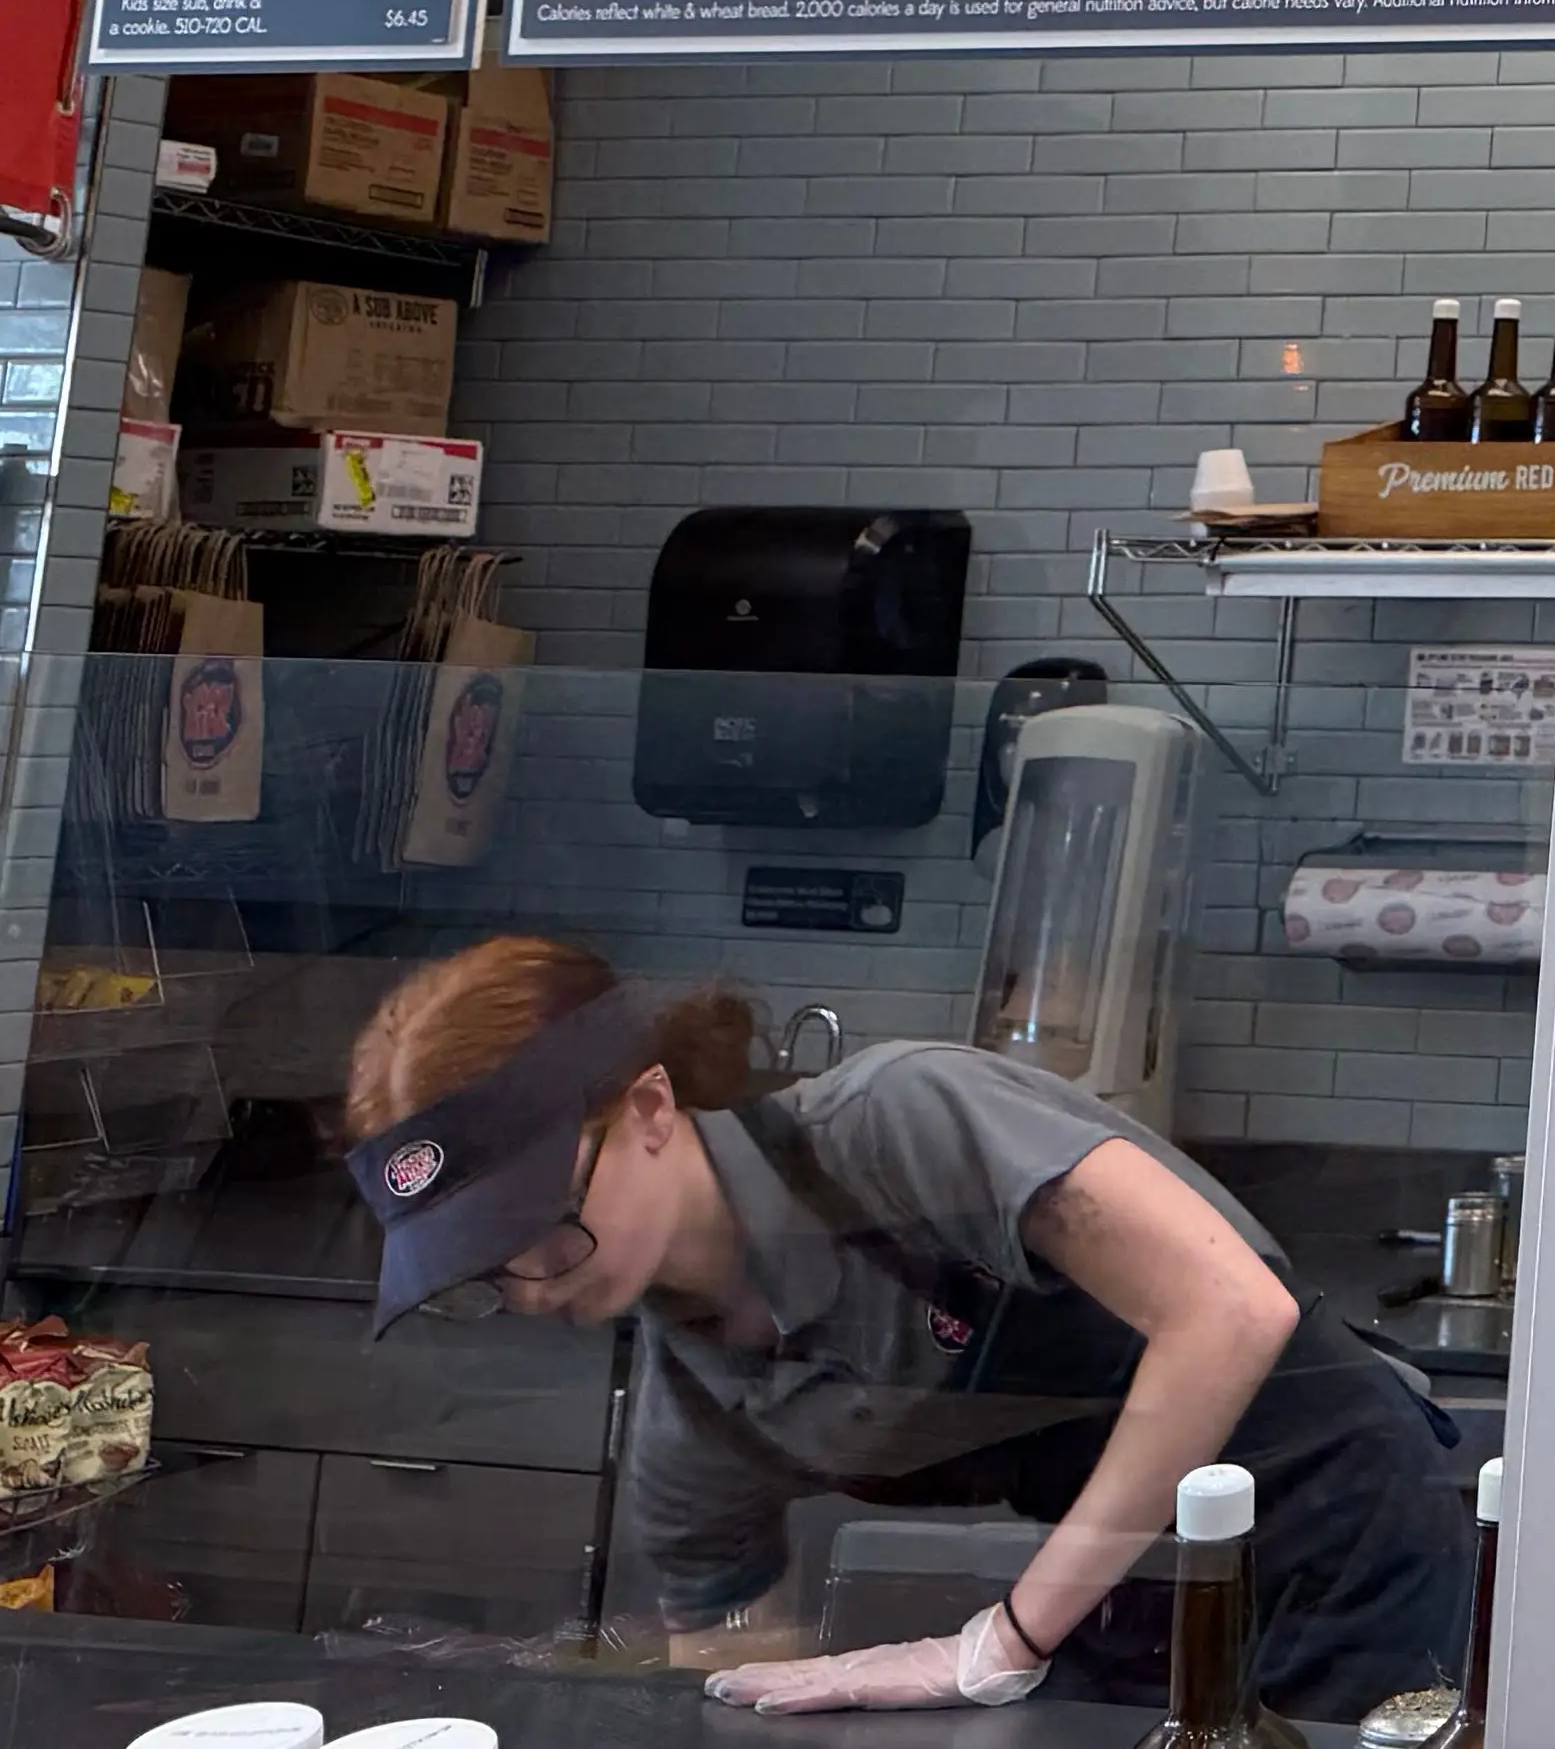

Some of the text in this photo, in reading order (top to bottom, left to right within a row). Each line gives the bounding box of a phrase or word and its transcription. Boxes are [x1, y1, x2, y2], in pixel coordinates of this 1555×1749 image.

[353, 294, 439, 327] A SUB ABOVE
[1378, 463, 1509, 498] Premium
[1516, 465, 1553, 489] RED
